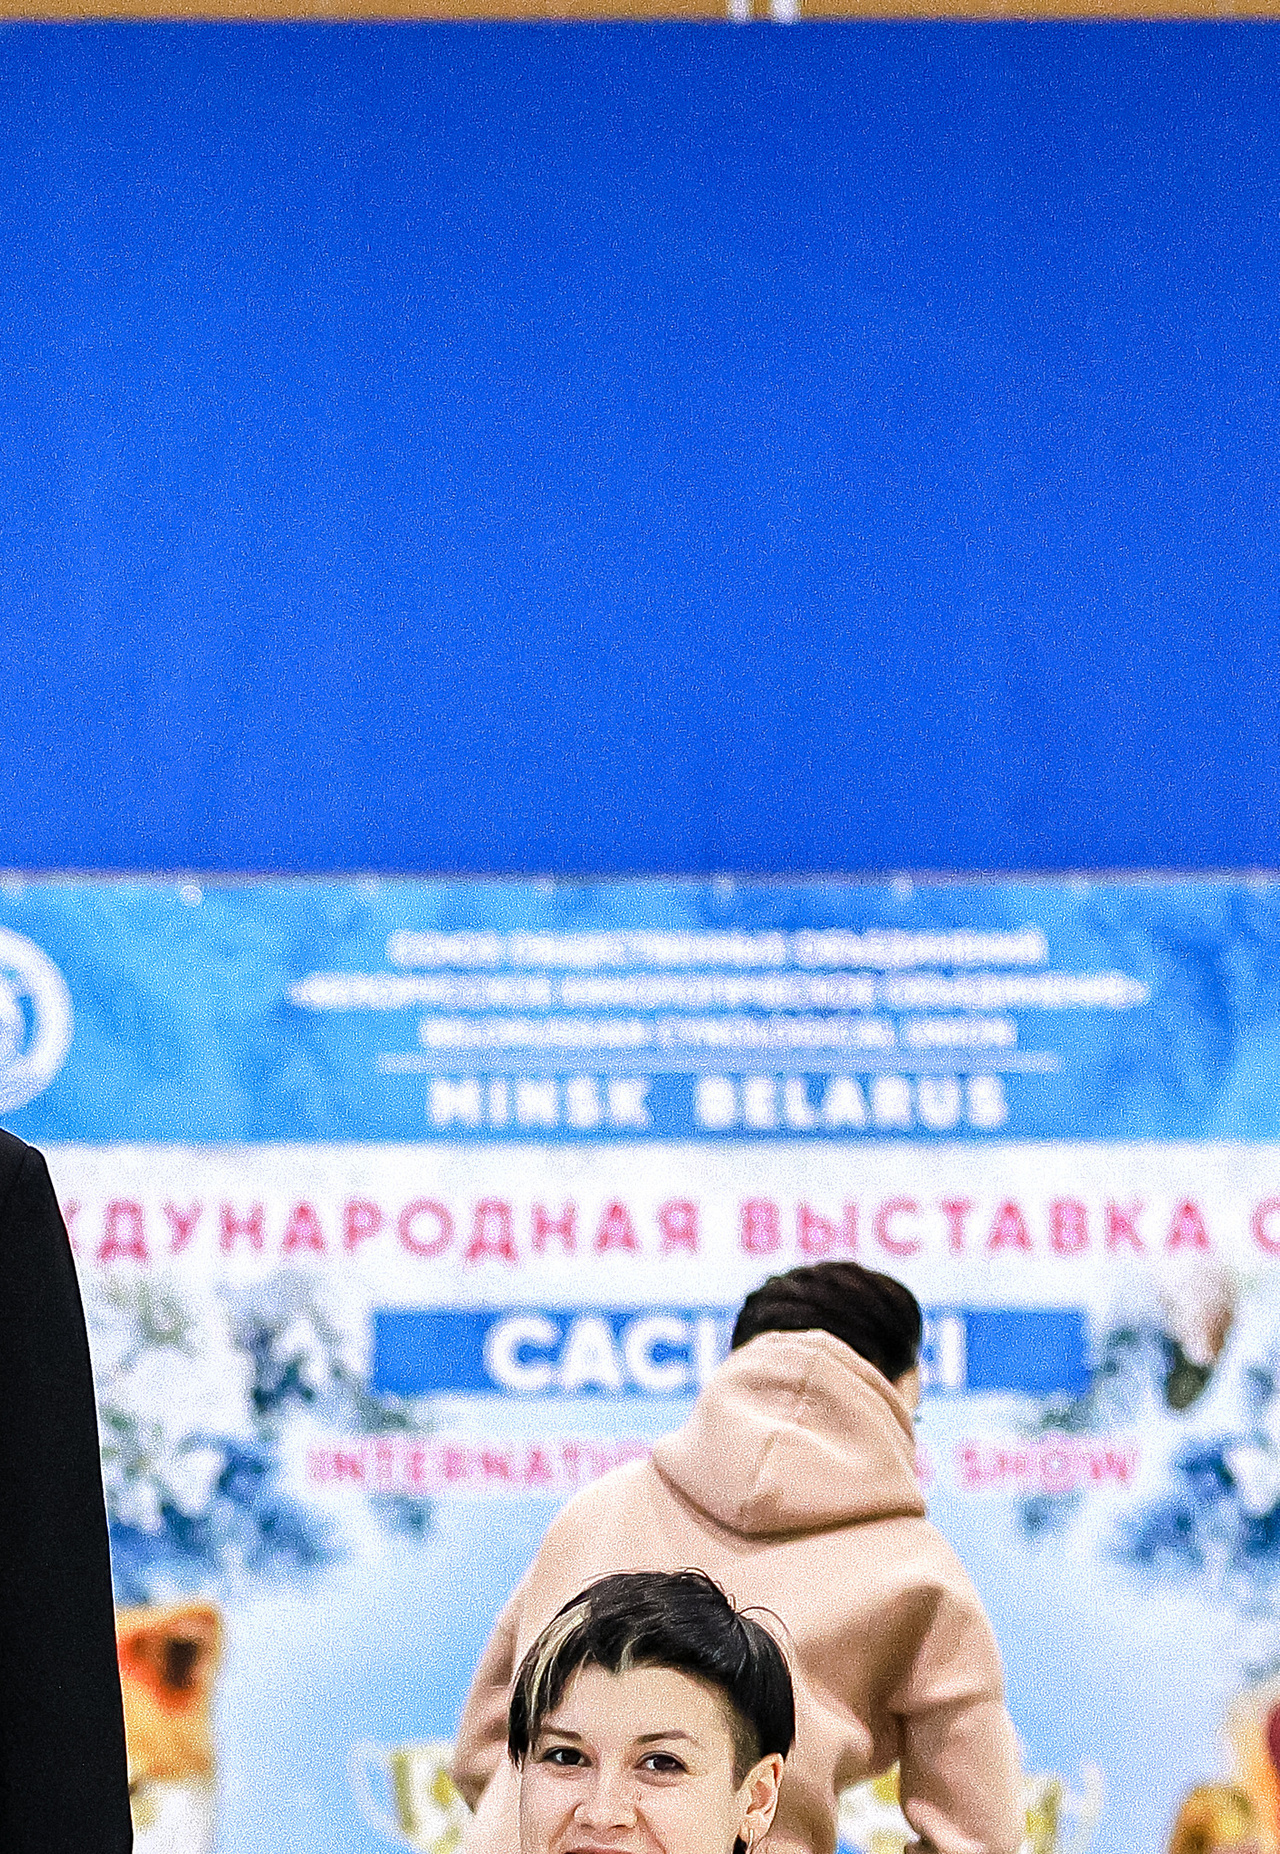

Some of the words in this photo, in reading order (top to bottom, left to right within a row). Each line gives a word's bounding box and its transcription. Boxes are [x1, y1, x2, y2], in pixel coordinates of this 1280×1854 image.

[427, 1076, 651, 1127] MINSK
[695, 1076, 1008, 1129] BELARUS
[62, 1198, 698, 1263] ДУНАРОДНАЯ
[740, 1198, 1214, 1255] ВЫСТАВКА
[482, 1315, 726, 1391] CACI
